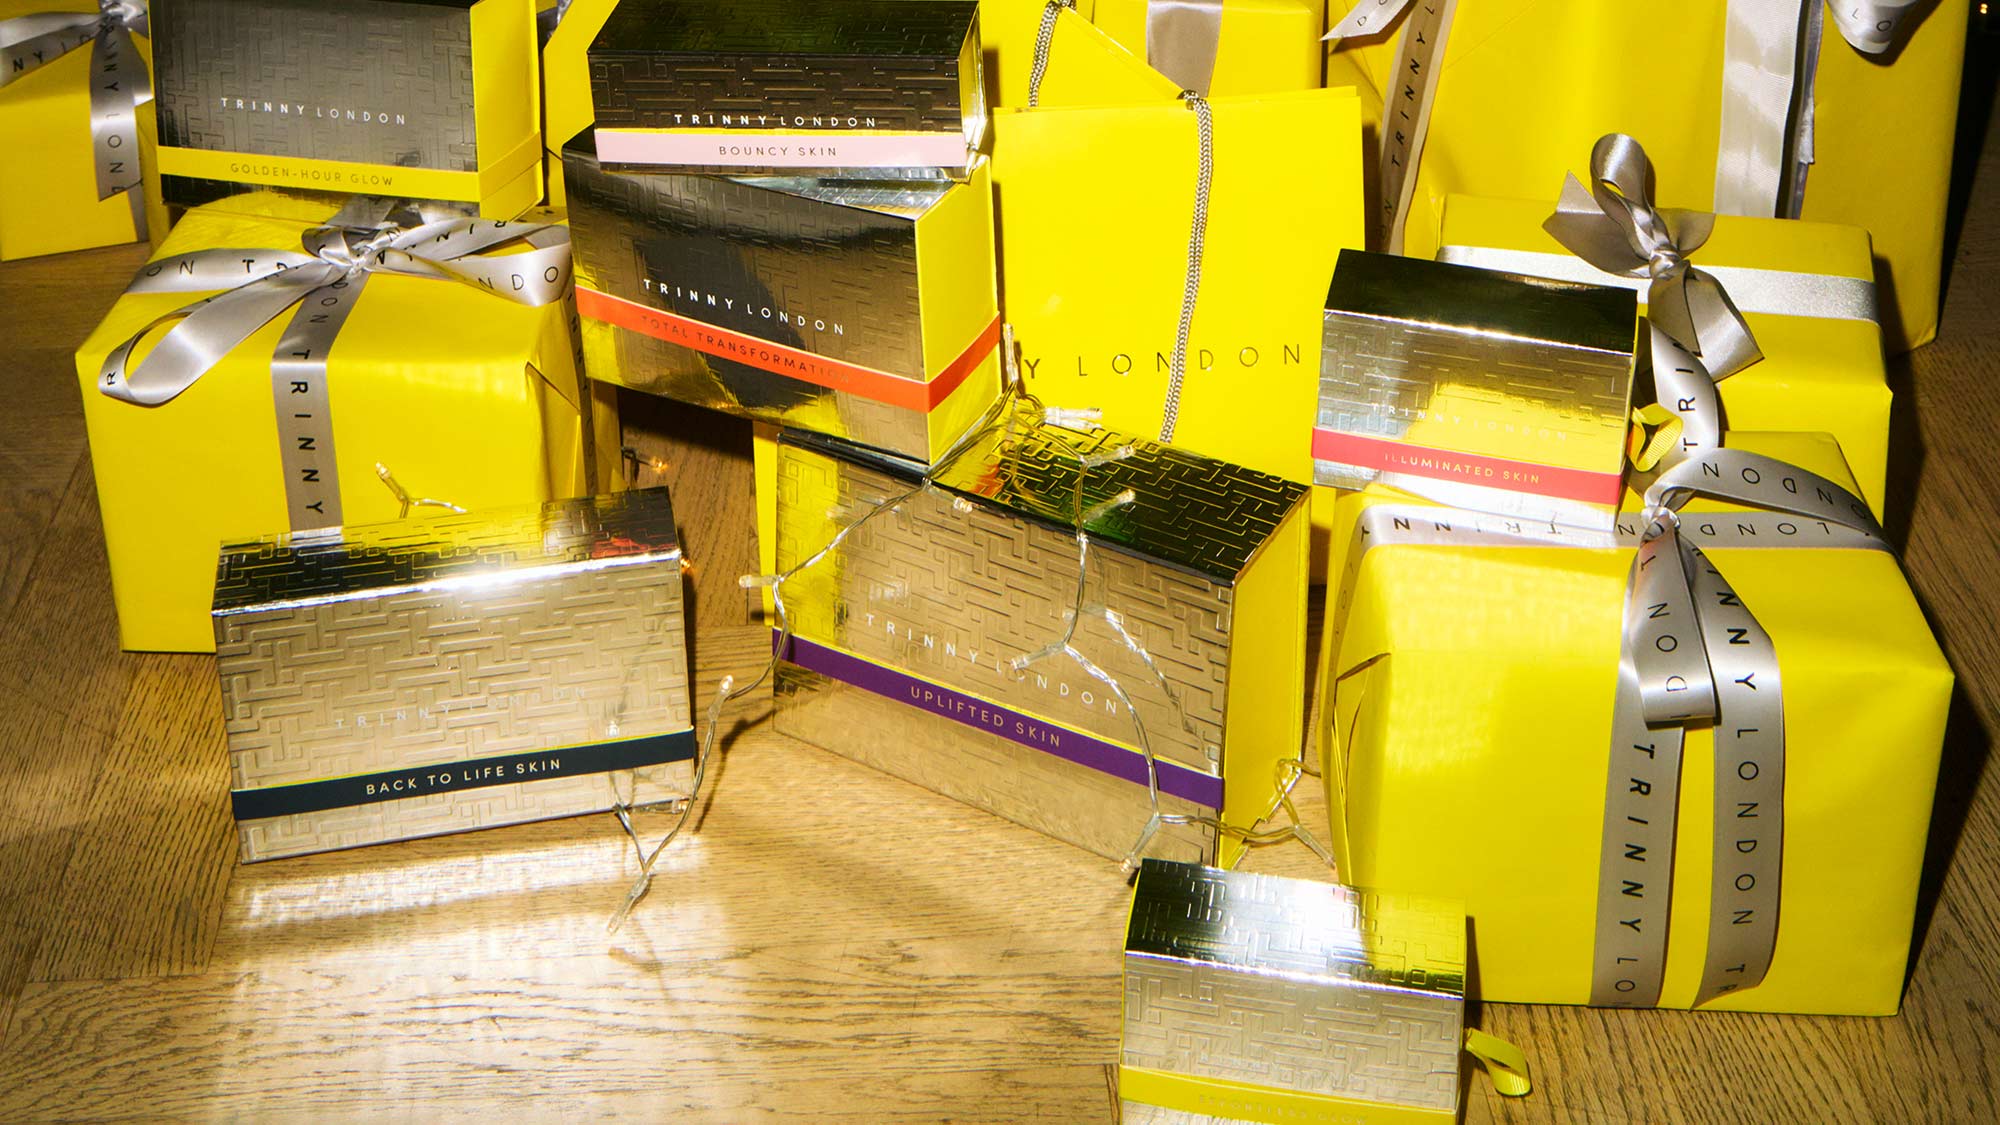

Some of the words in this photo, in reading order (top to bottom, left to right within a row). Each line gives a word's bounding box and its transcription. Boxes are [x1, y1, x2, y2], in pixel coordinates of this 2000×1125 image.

[221, 97, 305, 116] TRINNY
[317, 107, 406, 126] LONDON
[1391, 31, 1427, 167] TRINNY
[674, 113, 767, 126] TRINNY
[780, 115, 876, 128] LONDON
[718, 145, 788, 157] BOUNCY
[797, 146, 838, 157] SKIN
[230, 162, 342, 182] GOLDEN-HOUR
[350, 173, 393, 187] GLOW
[643, 278, 734, 310] TRINNY
[747, 303, 844, 336] LONDON
[641, 314, 688, 339] TOTAL
[290, 348, 324, 514] TRINNY
[1370, 402, 1462, 425] TRINNY
[1384, 452, 1494, 478] ILLUMINATED
[1503, 470, 1541, 484] SKIN
[866, 613, 978, 664] TRINNY
[335, 704, 452, 729] TRINNY
[910, 686, 1004, 728] UPLIFTED
[1016, 721, 1061, 748] SKIN
[365, 779, 418, 796] BACK
[427, 772, 452, 786] TO
[464, 765, 506, 782] LIFE
[516, 758, 562, 775] SKIN
[1619, 743, 1656, 933] TRINNY
[1732, 728, 1760, 926] LONDON
